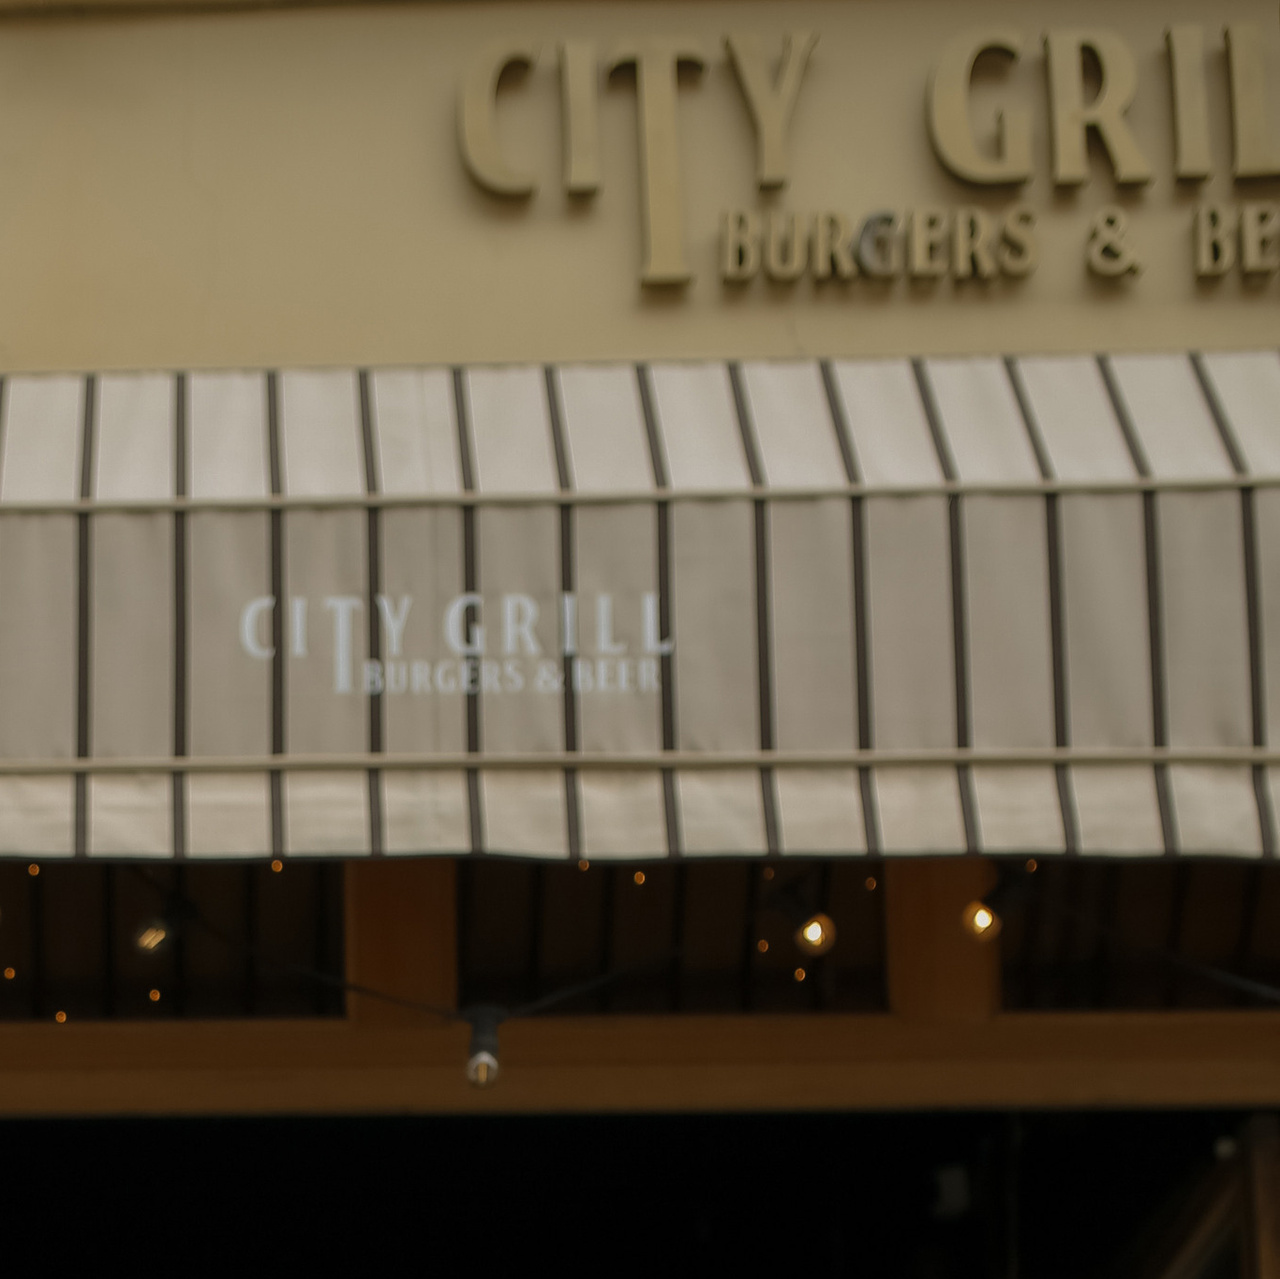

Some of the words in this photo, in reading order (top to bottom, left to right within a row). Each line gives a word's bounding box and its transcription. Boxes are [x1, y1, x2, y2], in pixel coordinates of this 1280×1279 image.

[457, 32, 816, 288] CITY
[723, 207, 1038, 282] BURGERS
[1087, 212, 1140, 278] &
[239, 594, 413, 696] CITY
[443, 592, 674, 657] GRILL
[363, 657, 524, 695] BURGERS
[572, 657, 661, 693] BEER
